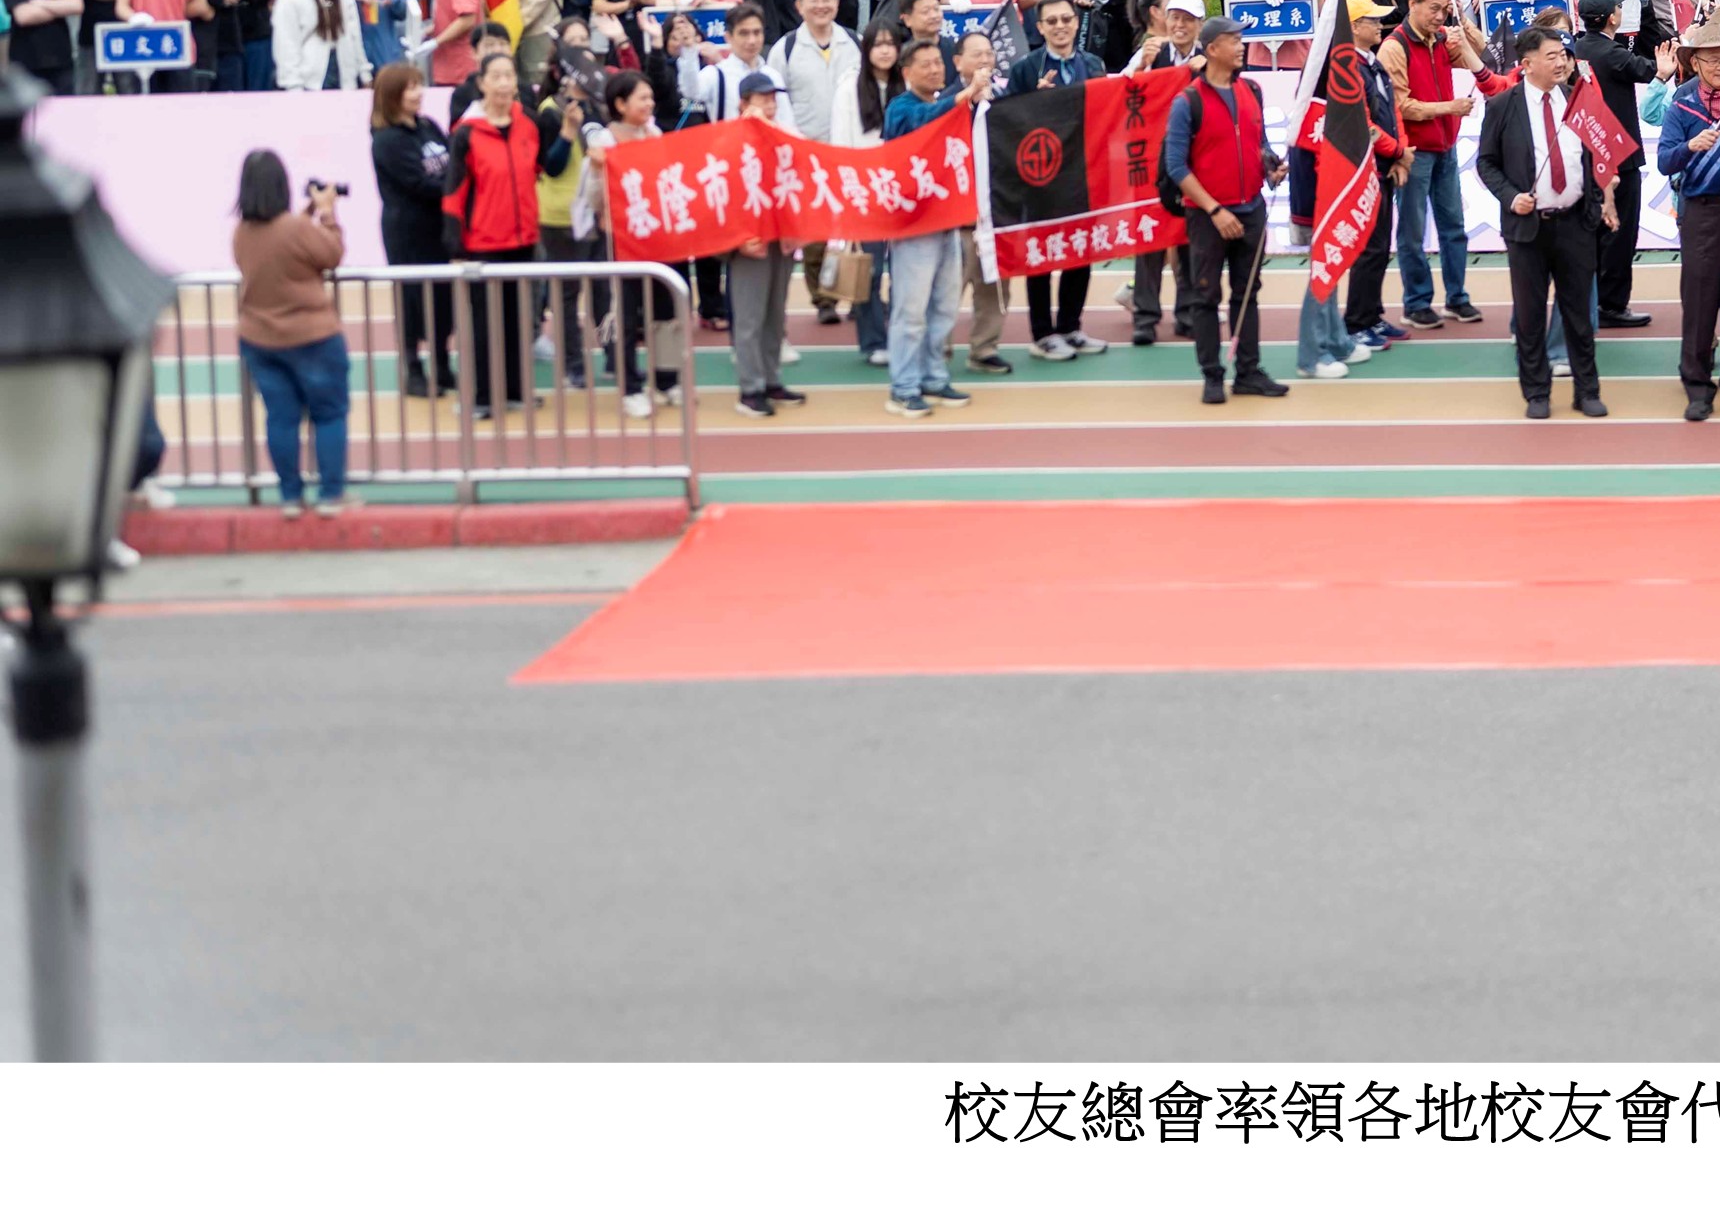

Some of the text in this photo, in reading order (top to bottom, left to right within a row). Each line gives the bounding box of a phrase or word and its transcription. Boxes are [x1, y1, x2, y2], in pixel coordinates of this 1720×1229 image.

[1239, 7, 1306, 28] 物理系
[620, 135, 971, 239] 基隆市東吳大學校友會
[1025, 214, 1160, 267] 基隆市校友會
